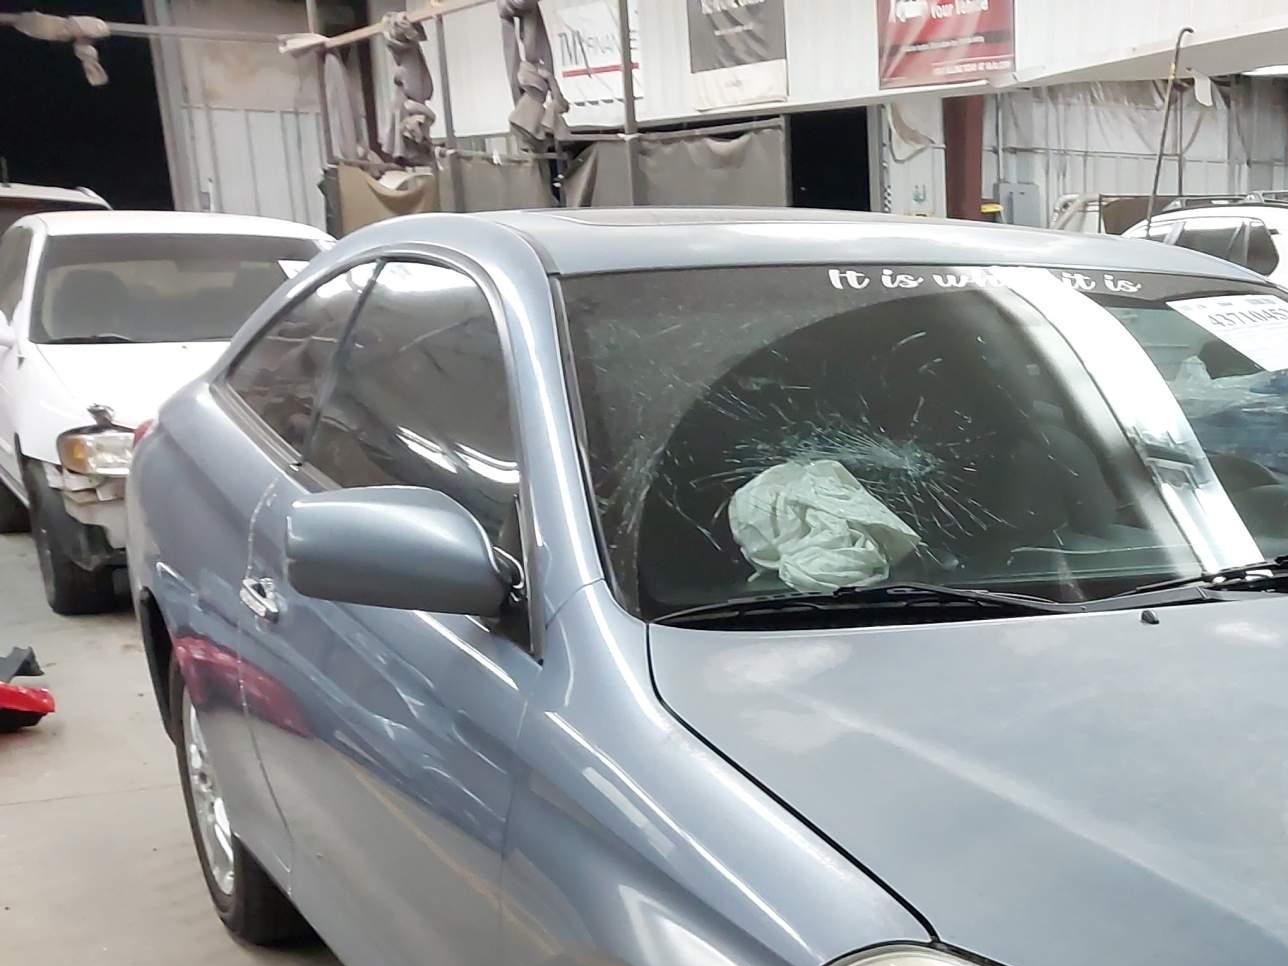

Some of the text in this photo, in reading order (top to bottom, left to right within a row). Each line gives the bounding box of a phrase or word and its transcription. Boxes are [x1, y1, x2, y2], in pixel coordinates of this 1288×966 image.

[828, 268, 870, 289] It
[881, 269, 924, 289] is
[1104, 273, 1142, 293] is
